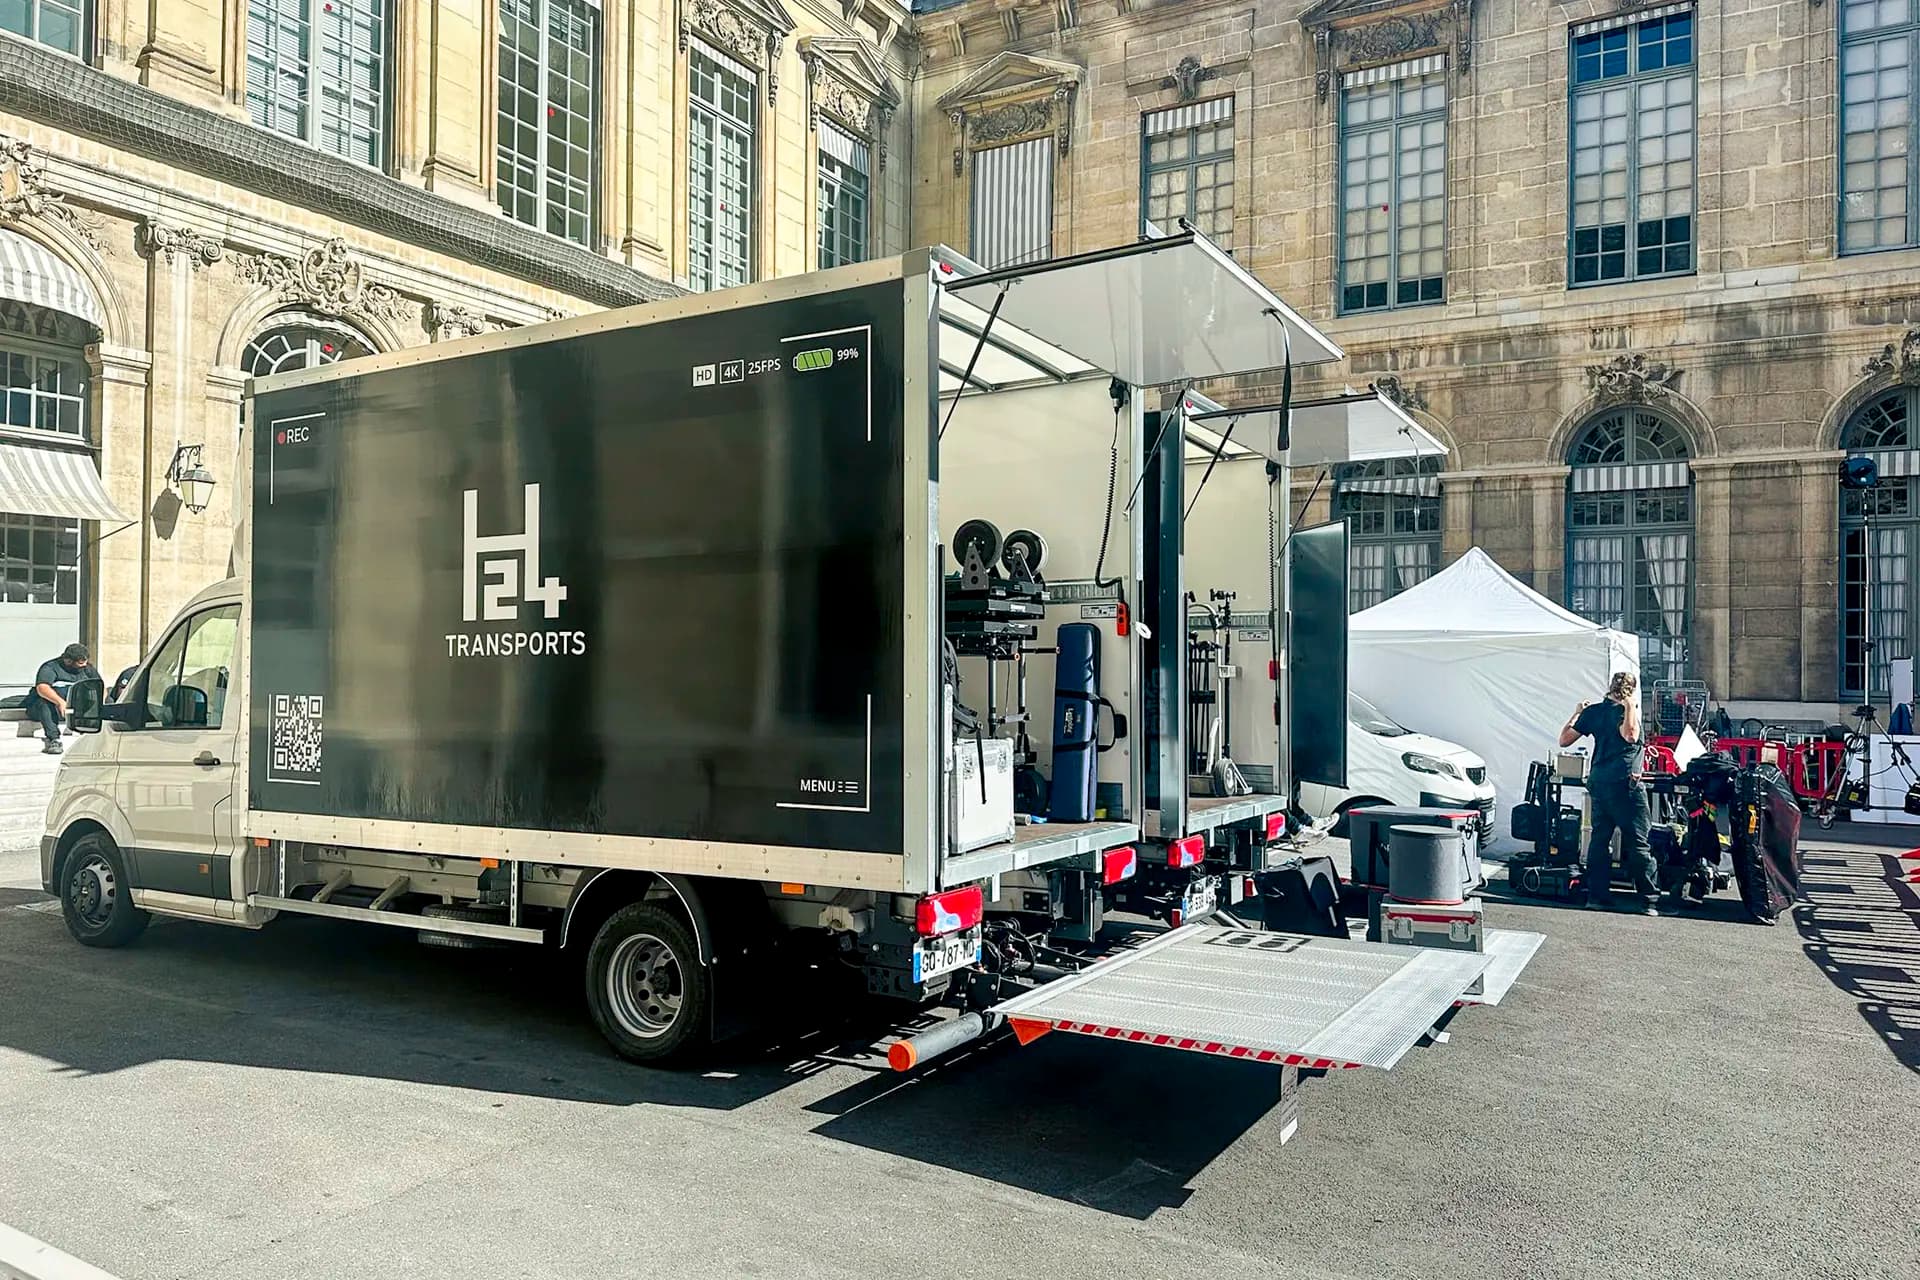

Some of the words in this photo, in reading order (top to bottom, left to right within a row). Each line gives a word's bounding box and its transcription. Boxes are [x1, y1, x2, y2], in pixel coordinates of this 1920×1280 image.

[695, 369, 713, 382] HD
[723, 364, 739, 379] 4K
[748, 358, 781, 374] 25FPS
[837, 348, 859, 361] 99%
[286, 426, 310, 444] REC
[445, 631, 586, 656] TRANSPORTS
[800, 779, 836, 793] MENU
